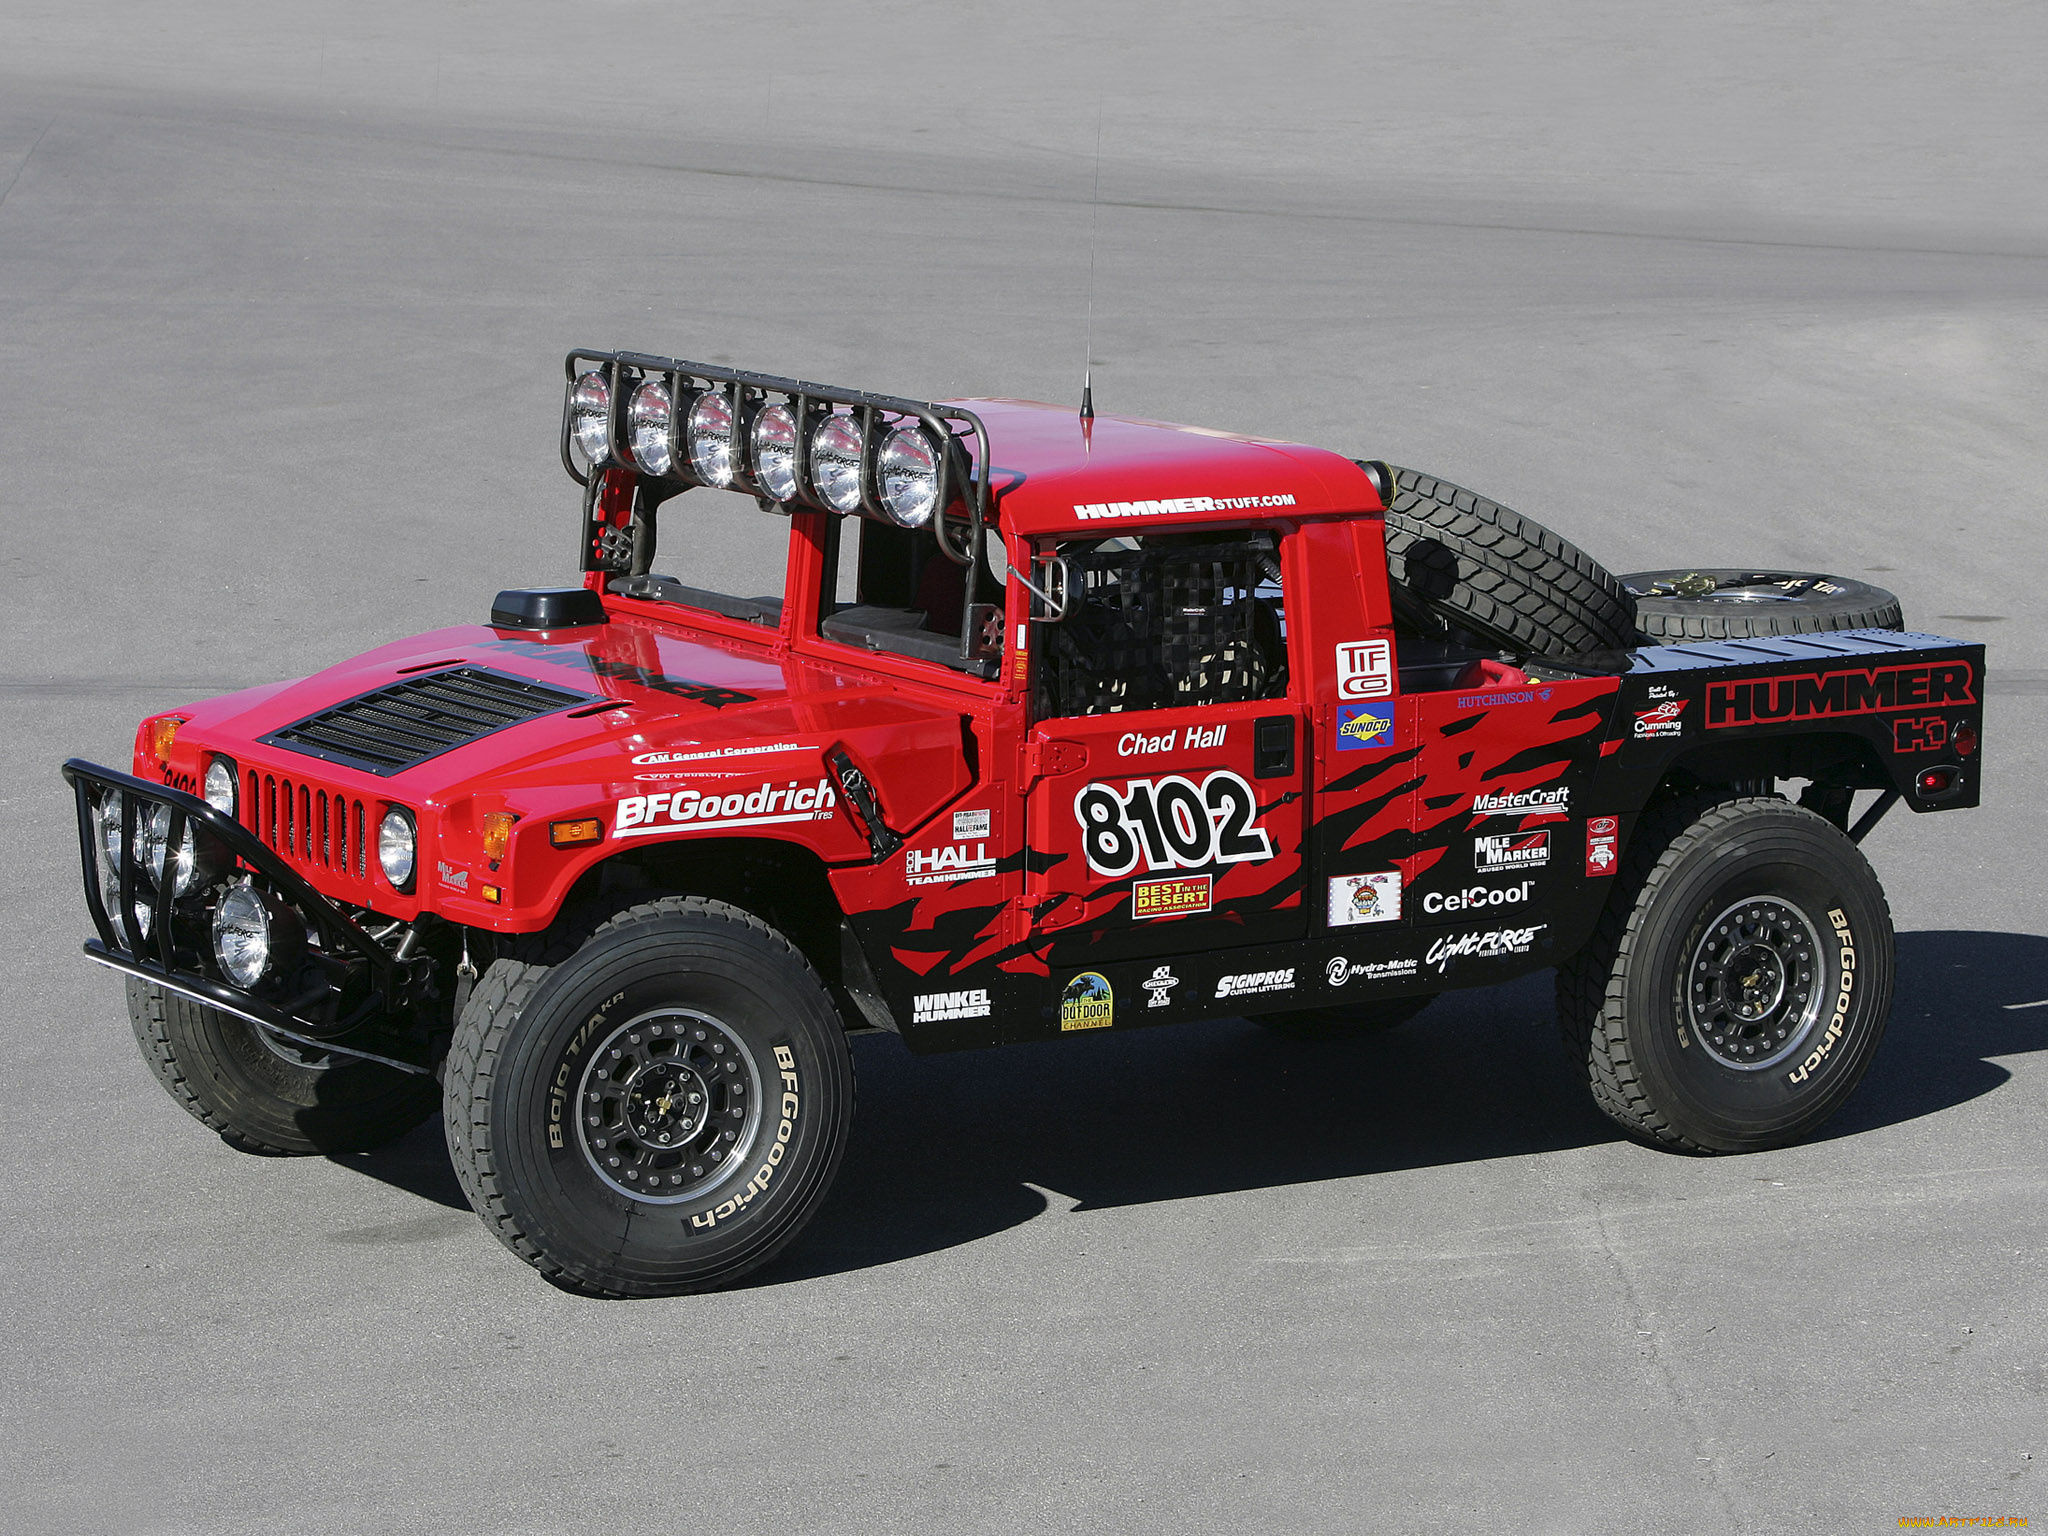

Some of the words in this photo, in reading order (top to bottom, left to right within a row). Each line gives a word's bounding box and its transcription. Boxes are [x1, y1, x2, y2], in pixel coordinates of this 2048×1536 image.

[1073, 494, 1296, 520] HUMMERSTUFF.COM
[1457, 691, 1534, 708] HUTCHINSON
[1705, 660, 1977, 730] HUMMER
[1343, 719, 1388, 734] SUNOCO
[1634, 720, 1681, 733] Cumming
[1893, 716, 1947, 753] H1
[1117, 729, 1177, 757] Chad
[1184, 724, 1227, 750] Hall
[649, 754, 670, 763] AM
[673, 749, 721, 761] General
[724, 742, 797, 756] Corporation
[616, 779, 836, 831] BFGoodrich
[1472, 786, 1570, 811] MasterCraft
[813, 810, 833, 820] Tires
[1073, 769, 1274, 877] 8102
[906, 850, 914, 873] ROD
[914, 843, 996, 873] HALL
[1477, 866, 1504, 874] ABUSED
[1505, 862, 1529, 871] WORLD
[1137, 891, 1208, 908] DESERT
[1138, 883, 1184, 897] BEST
[1423, 881, 1528, 914] CelCool
[1163, 902, 1207, 911] ASSOCIATION
[1351, 959, 1418, 975] Hydra-Matic
[1367, 968, 1416, 980] Transmissions
[1230, 987, 1258, 996] CUSTOM
[1259, 982, 1296, 993] LETTERING
[1788, 908, 1856, 1085] BFGoodrich
[913, 989, 991, 1012] WINKEL
[913, 1005, 991, 1023] HUMMER
[1063, 1004, 1110, 1020] OUTDOOR
[1064, 1019, 1110, 1030] CHANNEL
[549, 1062, 571, 1149] Baja
[566, 1013, 607, 1056] T/A
[601, 991, 625, 1012] KR
[692, 1045, 799, 1228] BFGoodrich
